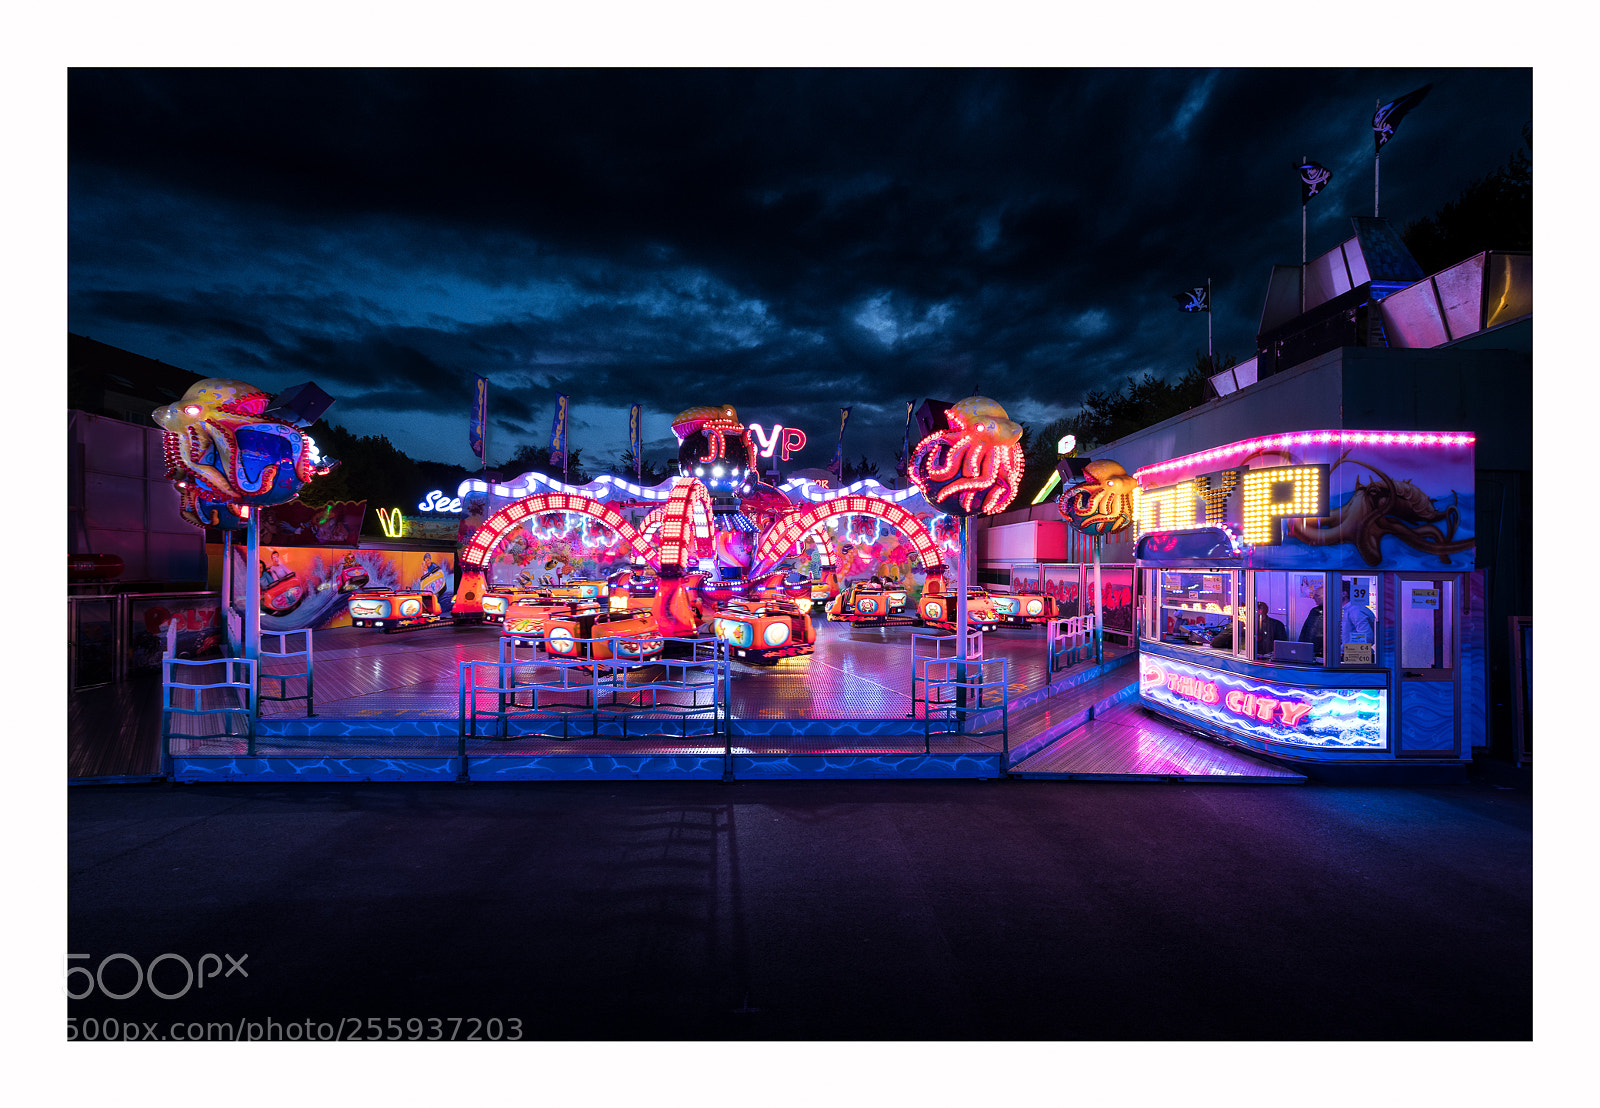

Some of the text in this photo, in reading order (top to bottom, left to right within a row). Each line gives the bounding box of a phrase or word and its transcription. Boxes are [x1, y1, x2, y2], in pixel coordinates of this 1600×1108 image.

[1354, 589, 1366, 598] 39
[1167, 672, 1221, 705] THIS
[1225, 690, 1313, 728] CITY
